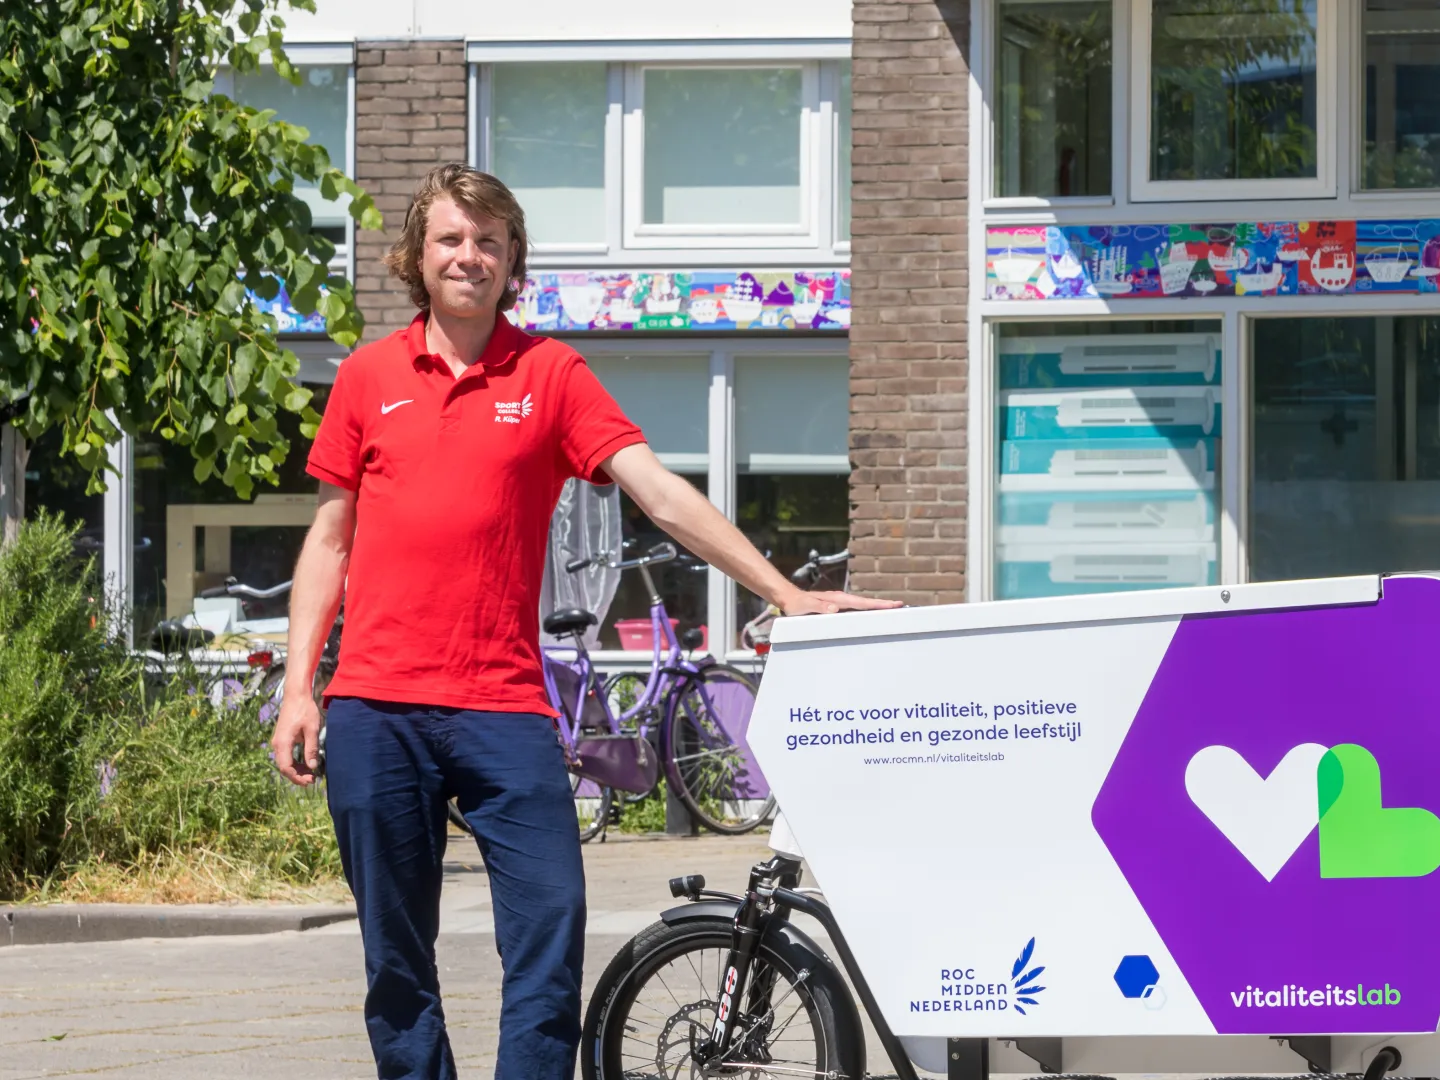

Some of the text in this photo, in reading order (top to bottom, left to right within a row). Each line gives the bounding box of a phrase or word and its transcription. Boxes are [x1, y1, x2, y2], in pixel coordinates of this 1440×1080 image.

[790, 699, 1077, 723] Hét roc voor vitaliteit, positieve
[786, 722, 1082, 751] gezondheid en gezonde leefstijl
[863, 752, 1005, 765] www.rocmn.nl/vitaliteitslab
[941, 968, 975, 981] ROC
[941, 983, 1007, 996] MIDDEN
[1230, 983, 1402, 1008] vitaliteitslab
[910, 999, 1008, 1012] NEDERLAND
